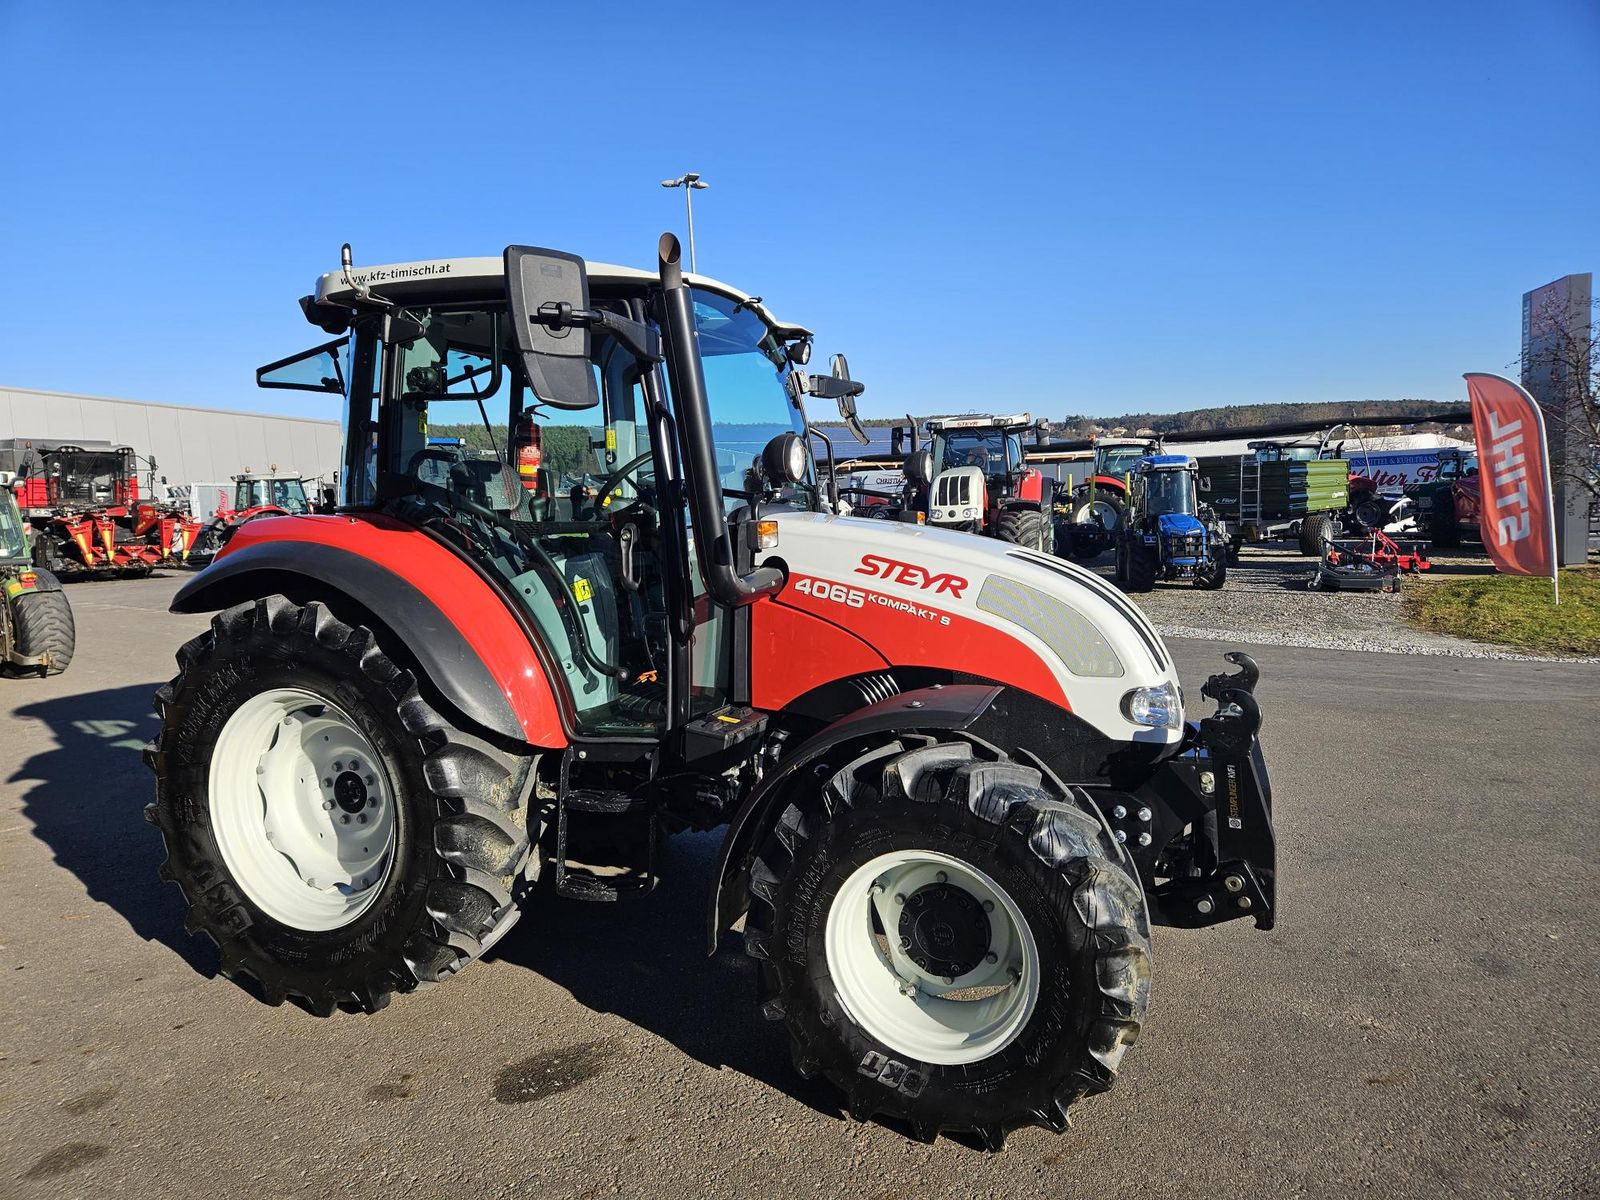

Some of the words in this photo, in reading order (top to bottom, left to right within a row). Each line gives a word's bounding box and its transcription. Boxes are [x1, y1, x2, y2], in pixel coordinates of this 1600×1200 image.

[340, 263, 451, 285] www.kfz-timischl.at
[854, 553, 969, 599] STEYR
[794, 578, 866, 609] 4065
[867, 593, 938, 621] KOMPAKT
[939, 615, 951, 626] S
[191, 859, 255, 937] BKT
[857, 1050, 923, 1098] BKT
